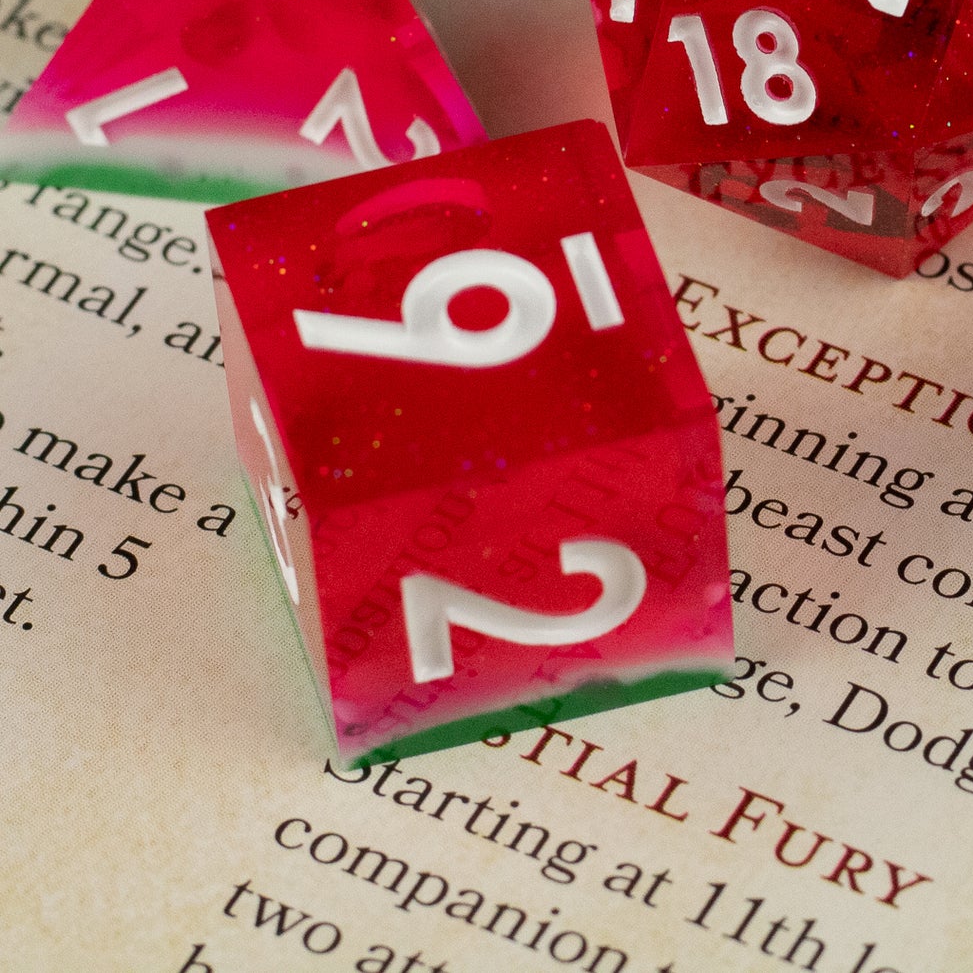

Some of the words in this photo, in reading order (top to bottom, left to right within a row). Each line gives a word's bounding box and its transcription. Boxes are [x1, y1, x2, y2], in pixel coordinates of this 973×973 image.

[65, 66, 189, 146] 1
[667, 6, 818, 126] 18
[0, 485, 85, 561] hin
[97, 534, 153, 580] 5
[13, 427, 187, 515] make
[196, 504, 237, 537] a
[723, 469, 887, 568] beast
[402, 536, 647, 684] 2
[728, 567, 908, 663] action
[222, 878, 344, 955] two
[273, 816, 630, 973] companion
[602, 859, 674, 909] at
[684, 881, 827, 973] 11th
